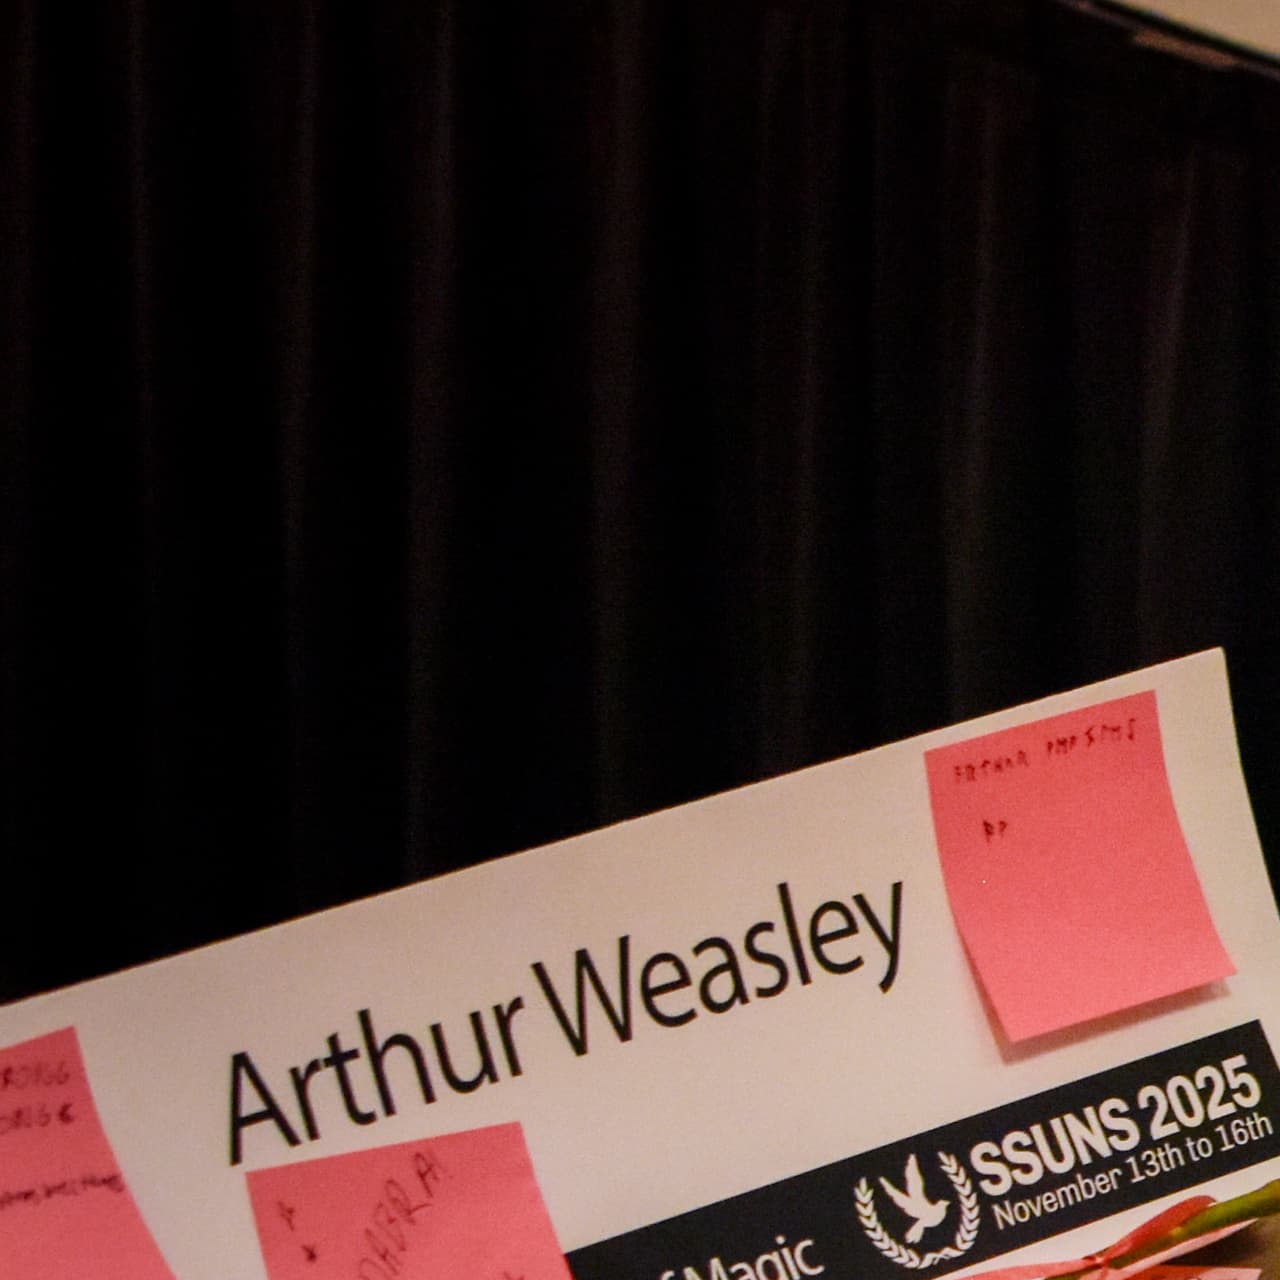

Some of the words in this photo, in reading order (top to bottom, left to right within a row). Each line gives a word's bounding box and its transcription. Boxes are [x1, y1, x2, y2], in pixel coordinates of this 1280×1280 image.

[229, 994, 524, 1166] Arthur
[530, 880, 904, 1058] Weasley
[969, 1098, 1141, 1196] SSUNS
[1138, 1054, 1262, 1141] 2025
[991, 1166, 1124, 1231] November
[1126, 1150, 1186, 1184] 13th
[1186, 1135, 1214, 1163] to
[1214, 1111, 1275, 1151] 16th
